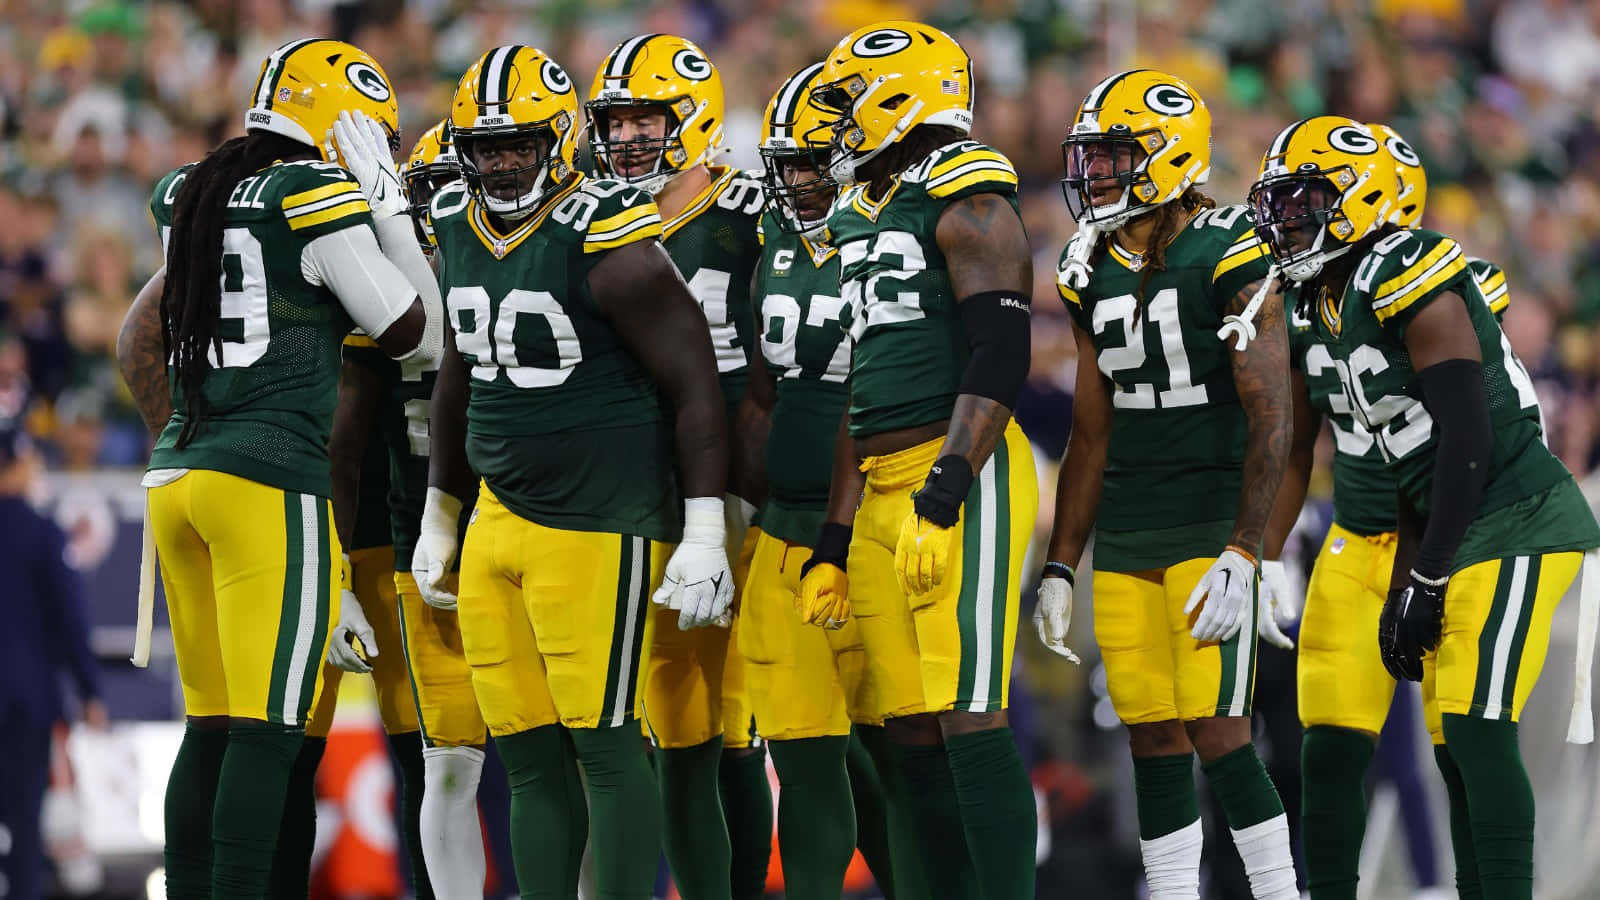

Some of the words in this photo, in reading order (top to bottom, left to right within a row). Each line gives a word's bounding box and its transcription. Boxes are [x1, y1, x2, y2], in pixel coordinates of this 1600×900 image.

[852, 29, 912, 58] G
[346, 62, 390, 102] G
[541, 60, 572, 95] G
[672, 49, 712, 82] G
[1144, 84, 1194, 117] G
[481, 117, 504, 125] PACKERS
[1328, 126, 1379, 154] G
[1384, 136, 1420, 167] G
[773, 250, 794, 270] C
[446, 286, 583, 389] 90
[760, 294, 851, 384] 97
[1092, 288, 1209, 409] 21
